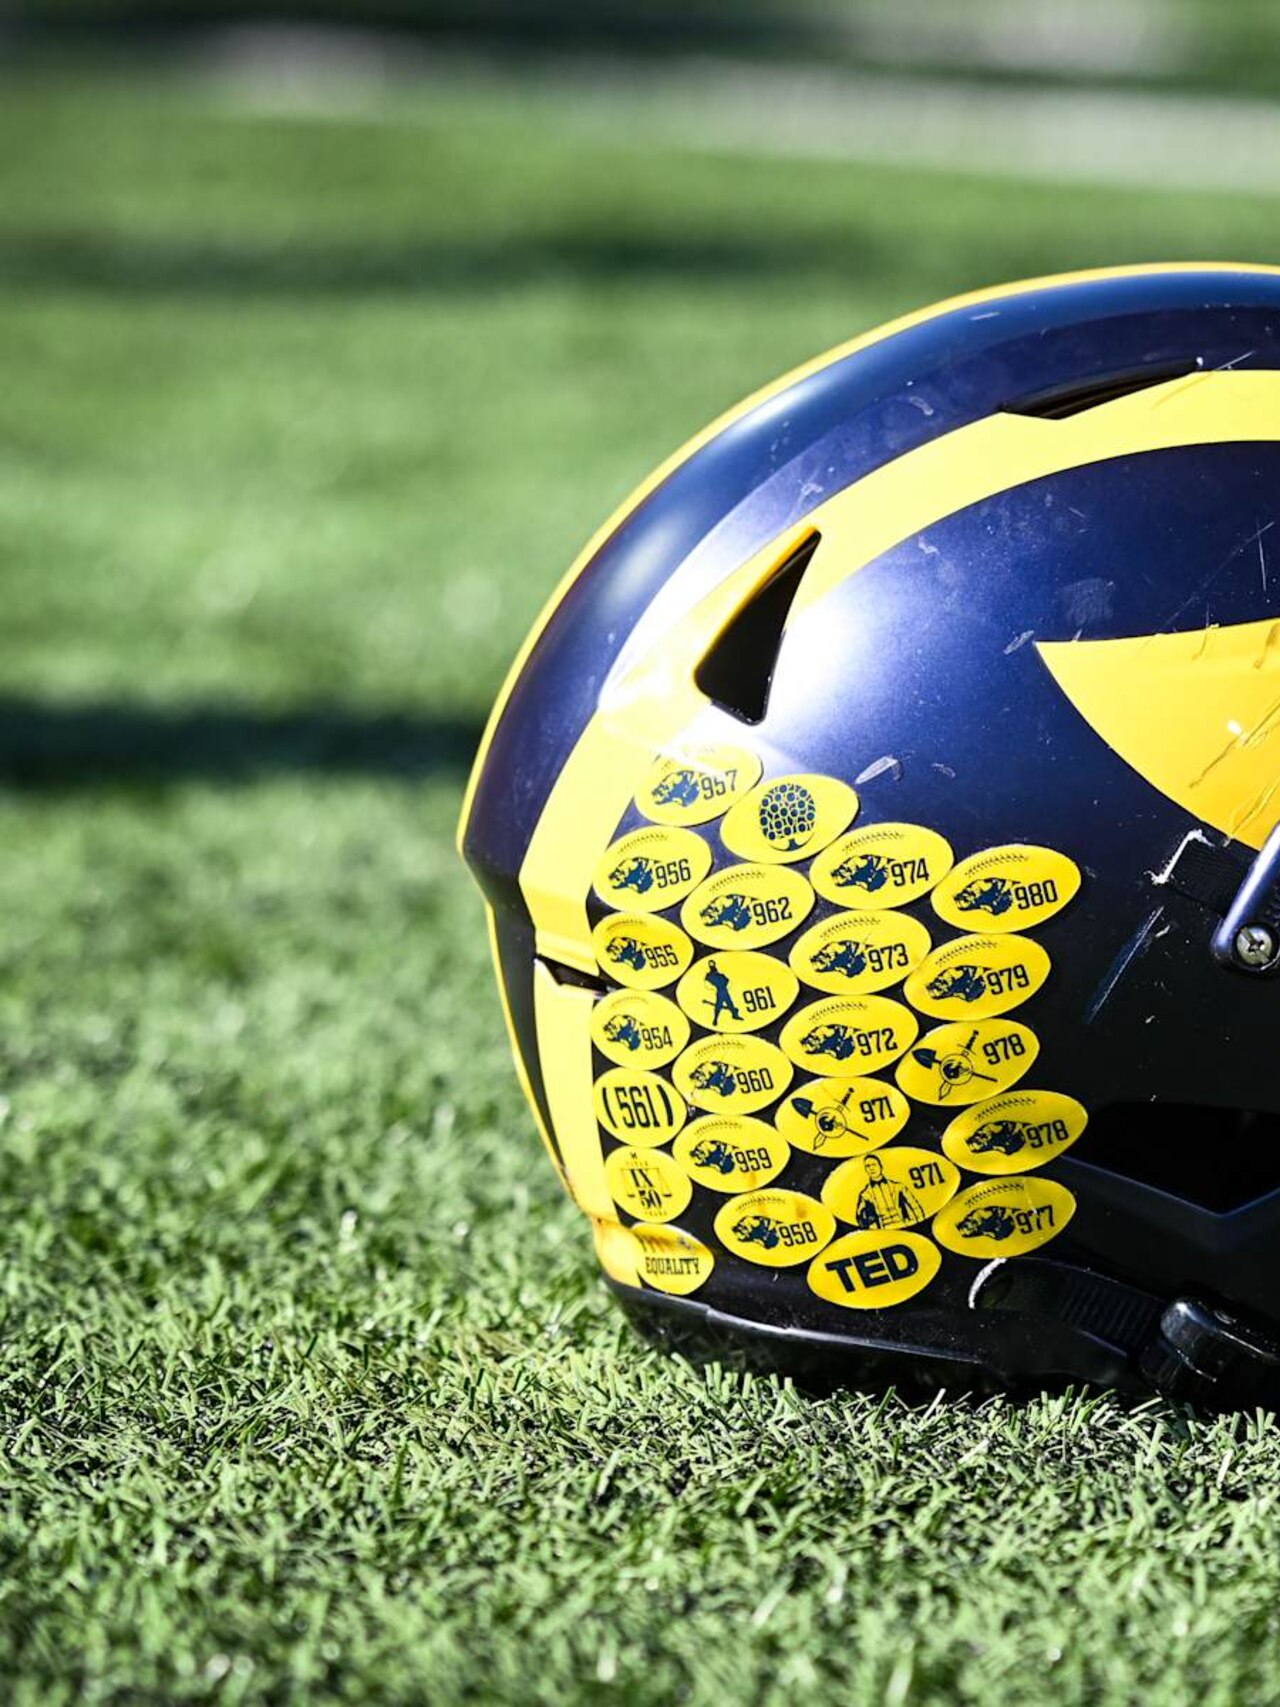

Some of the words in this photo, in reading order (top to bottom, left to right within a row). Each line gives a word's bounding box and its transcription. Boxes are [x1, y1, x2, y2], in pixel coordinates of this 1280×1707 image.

[700, 769, 738, 802] 957
[655, 858, 691, 889] 956
[890, 857, 930, 888] 974
[1013, 880, 1059, 911] 980
[752, 896, 793, 927] 962
[643, 944, 680, 969] 955
[868, 943, 910, 974] 973
[986, 964, 1031, 996] 979
[742, 986, 777, 1013] 961
[640, 1026, 675, 1051] 954
[856, 1027, 898, 1058] 972
[982, 1033, 1027, 1066] 978
[735, 1068, 775, 1095] 960
[601, 1084, 675, 1129] (561)
[858, 1096, 897, 1124] 971
[1025, 1119, 1070, 1150] 978
[734, 1147, 774, 1173] 959
[908, 1162, 946, 1189] 971
[638, 1189, 663, 1209] 50
[777, 1221, 818, 1248] 958
[1013, 1205, 1056, 1235] 977
[645, 1256, 701, 1276] EQUALITY
[825, 1243, 920, 1293] TED
